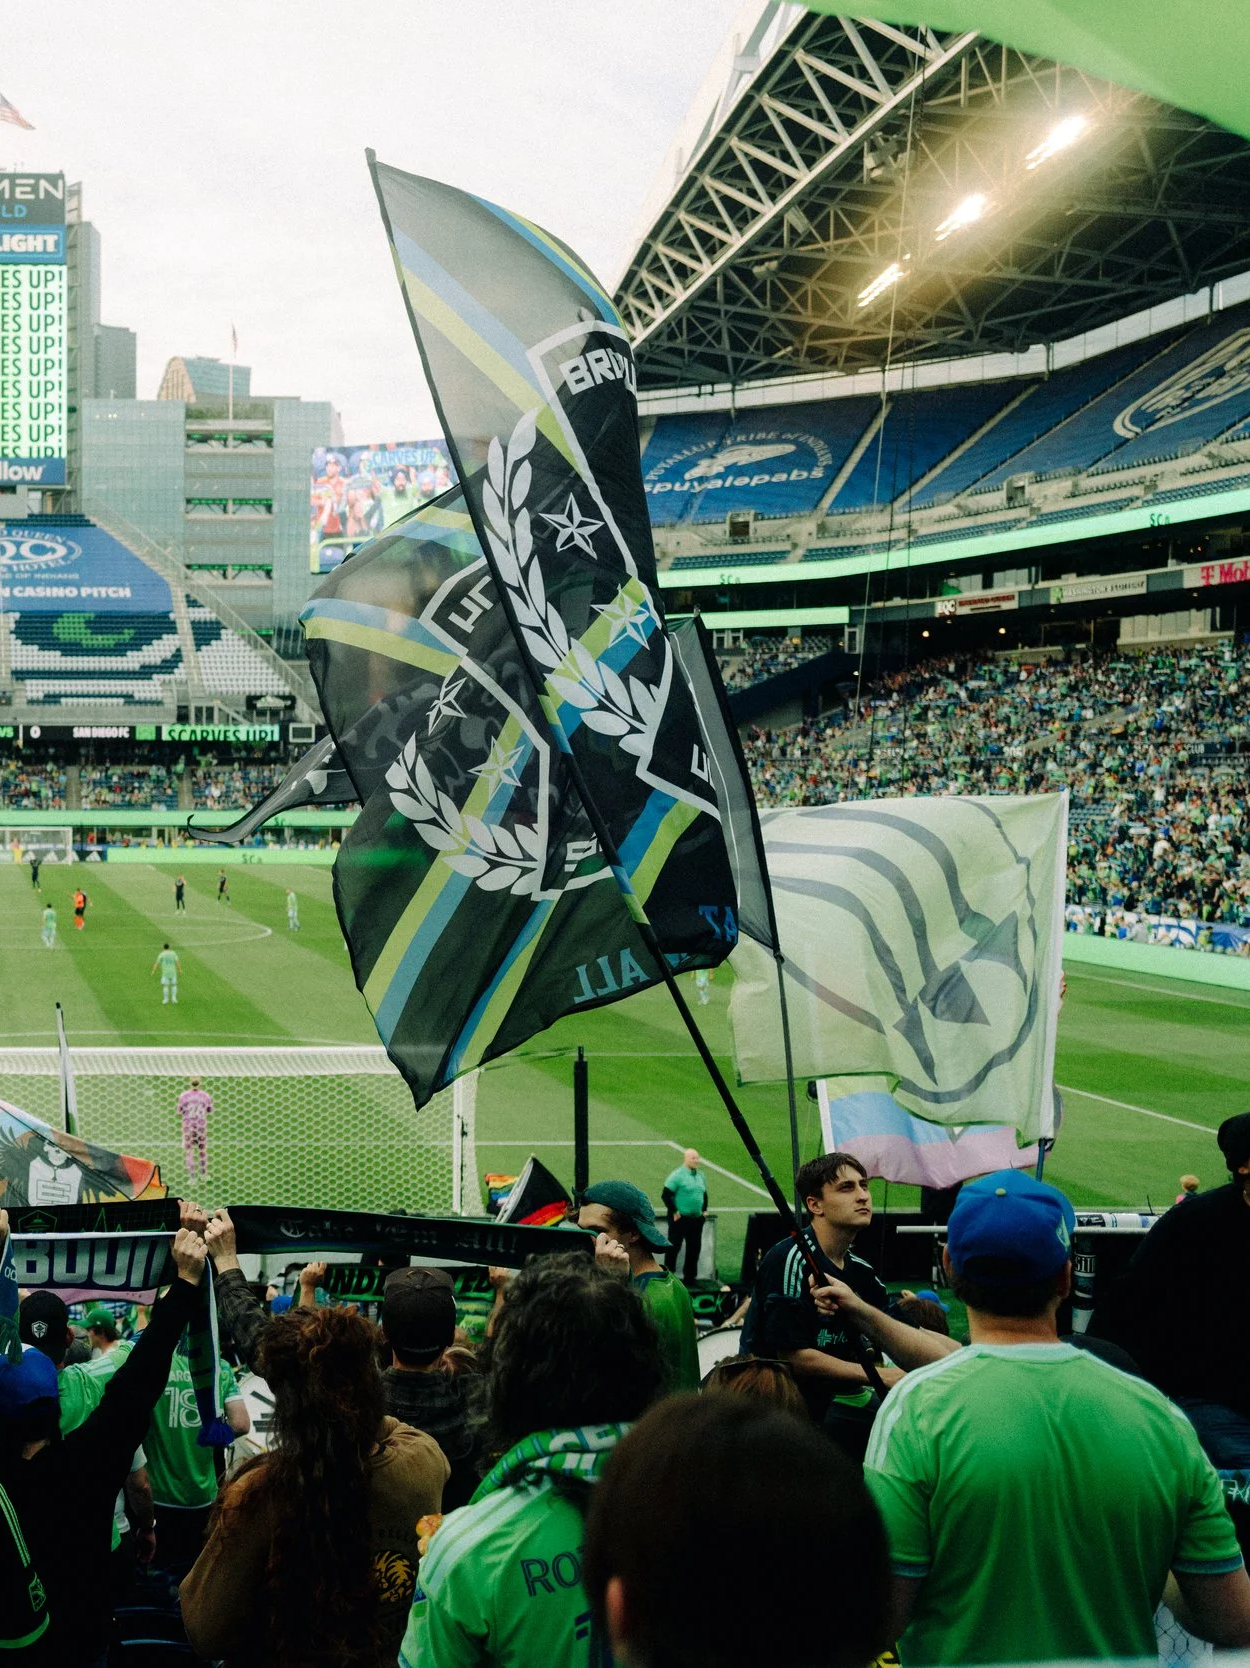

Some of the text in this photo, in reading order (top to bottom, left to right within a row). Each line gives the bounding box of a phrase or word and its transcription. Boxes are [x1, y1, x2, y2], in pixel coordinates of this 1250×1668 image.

[29, 270, 64, 288] UP!
[29, 292, 64, 310] UP!
[29, 314, 64, 332] UP!
[29, 336, 64, 354] UP!
[29, 358, 64, 376] UP!
[29, 380, 64, 398] UP!
[29, 402, 64, 420] UP!
[29, 424, 64, 442] UP!
[723, 431, 779, 445] TRIBE
[10, 527, 65, 543] QUEEN
[11, 557, 71, 573] HOTEL
[12, 585, 78, 598] CASINO
[80, 585, 132, 598] PITCH
[29, 725, 41, 739] 0
[72, 726, 91, 738] SAN
[91, 726, 118, 738] DIEGO
[118, 726, 130, 738] FC
[164, 1386, 203, 1428] 18
[520, 1544, 587, 1597] RO
